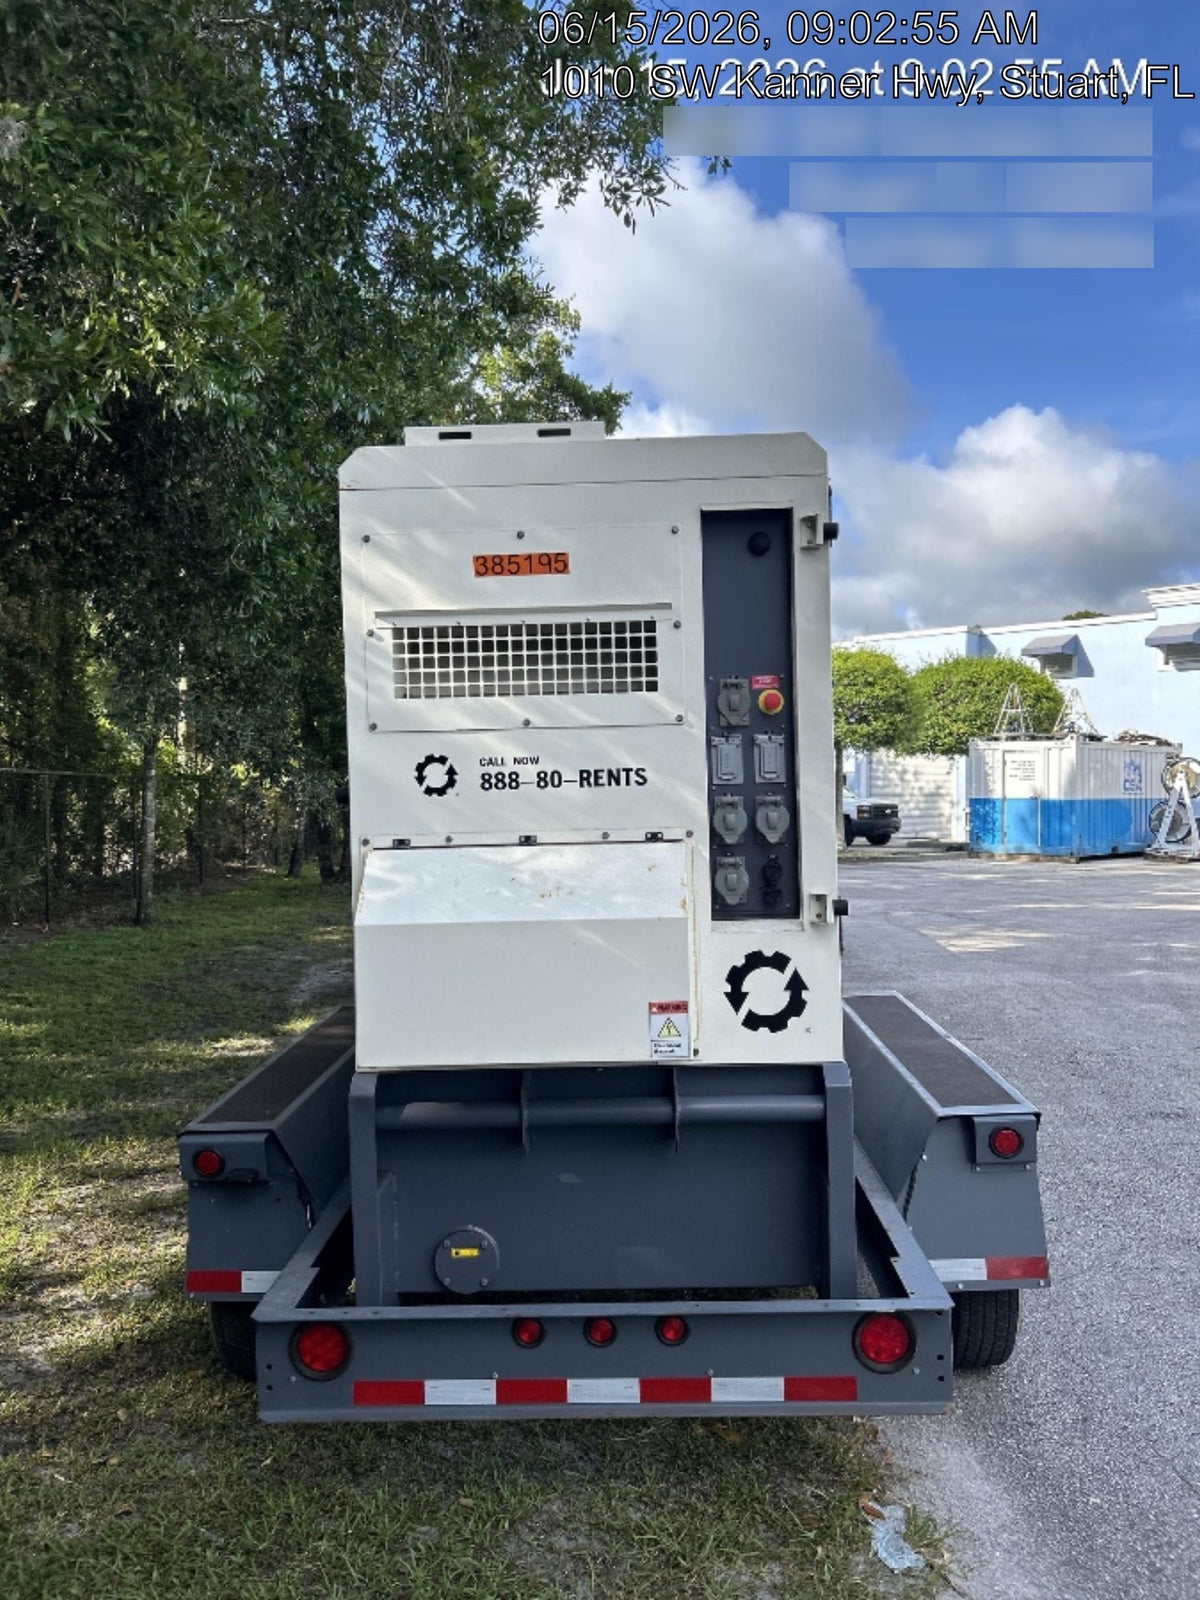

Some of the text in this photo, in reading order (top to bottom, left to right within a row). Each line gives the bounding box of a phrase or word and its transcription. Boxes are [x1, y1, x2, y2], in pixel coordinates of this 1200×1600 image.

[475, 552, 568, 577] 385195
[479, 756, 540, 767] CALL NOW
[480, 767, 648, 792] 888-80-RENTS
